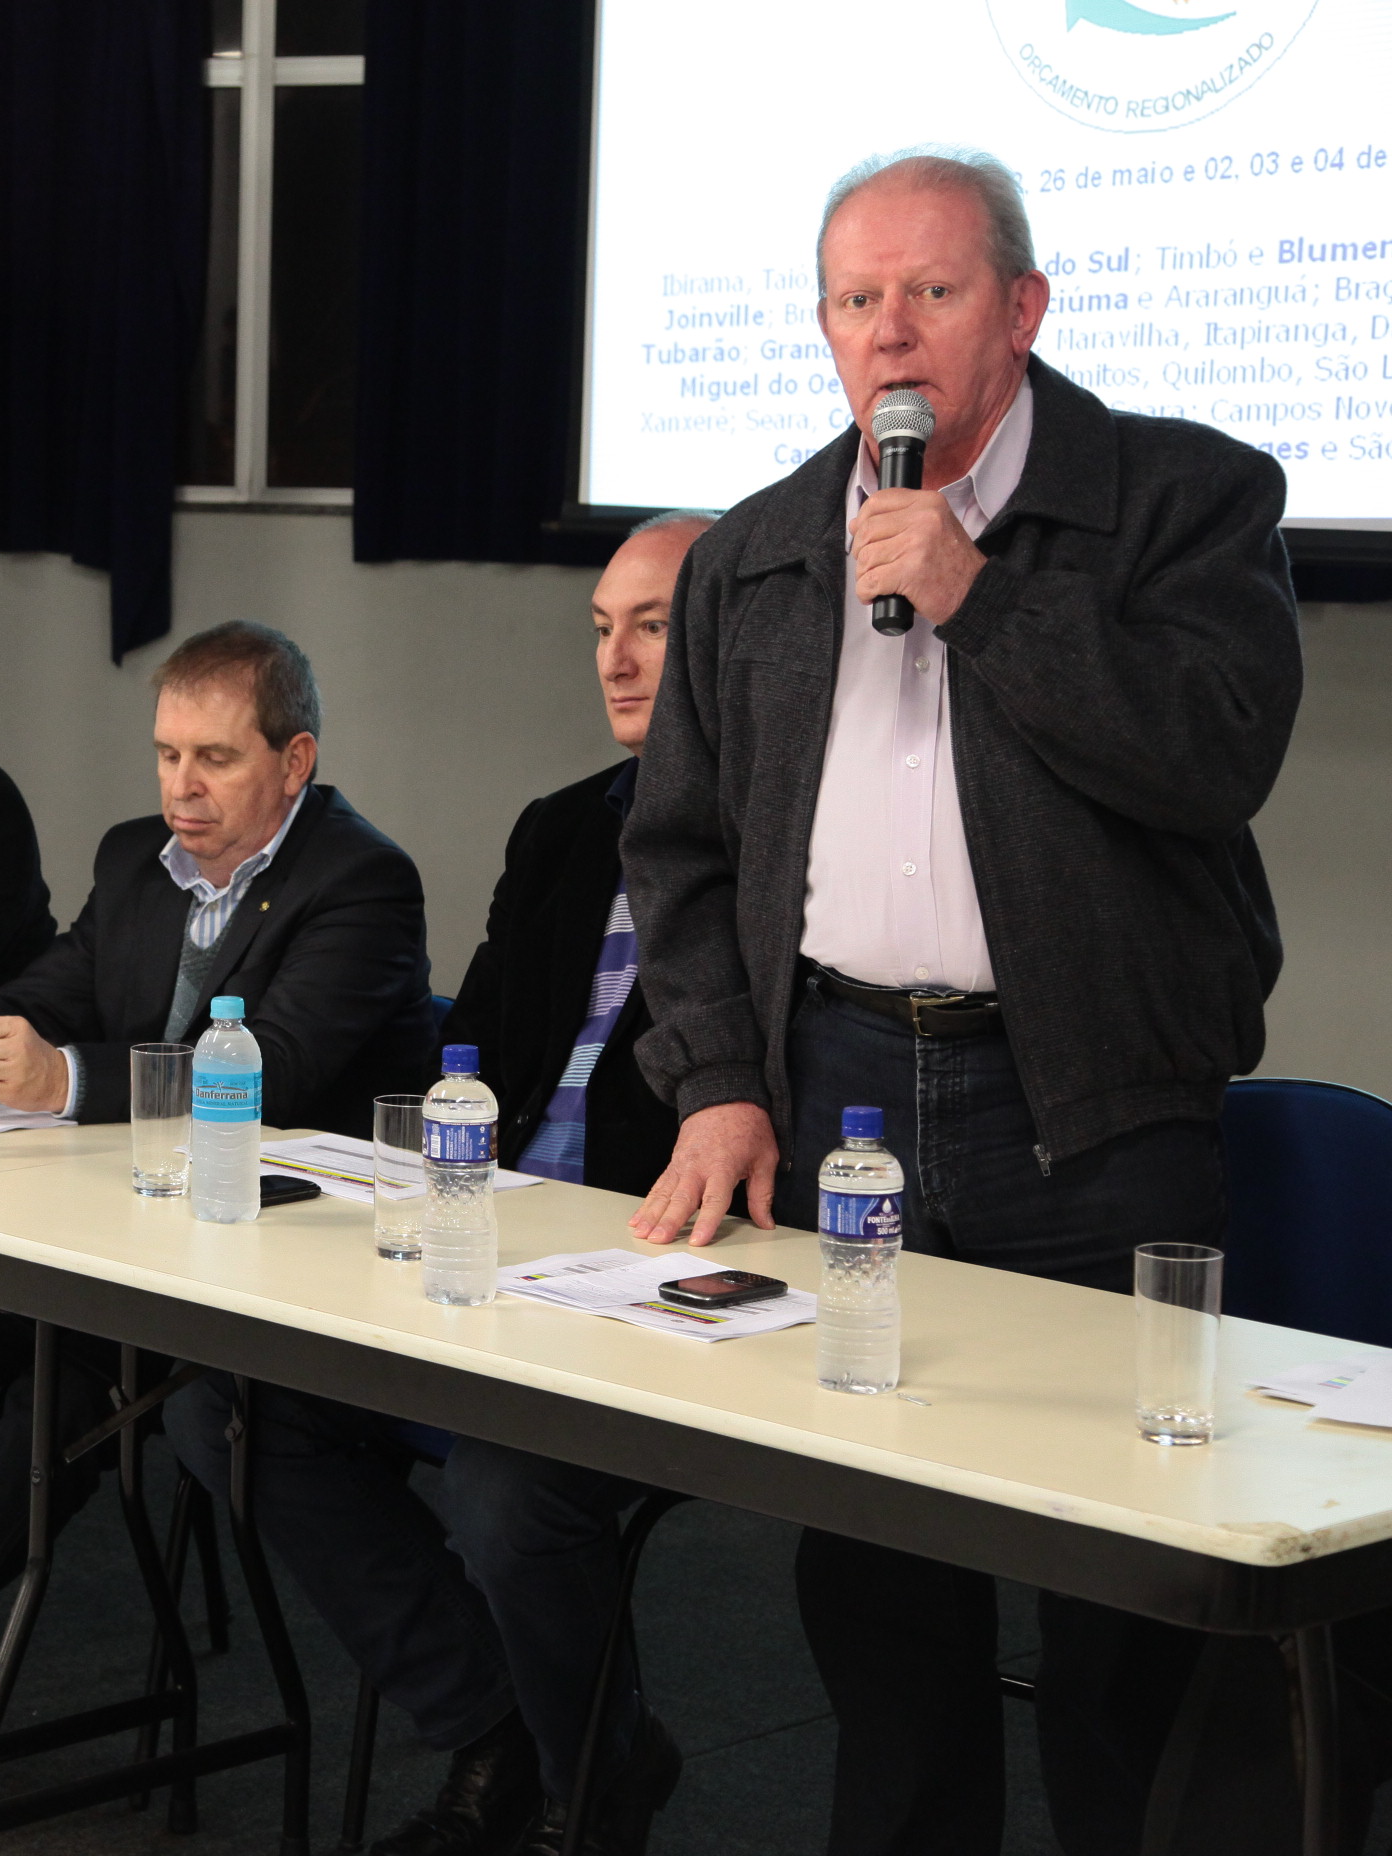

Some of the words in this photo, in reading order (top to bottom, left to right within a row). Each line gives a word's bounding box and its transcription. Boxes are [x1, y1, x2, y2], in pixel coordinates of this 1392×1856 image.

[1019, 43, 1119, 117] ORÇAMENTO
[1126, 31, 1275, 119] REGIONALIZADO
[1039, 168, 1066, 193] 26
[1075, 166, 1103, 190] de
[1112, 161, 1174, 187] maio
[1183, 165, 1196, 182] e
[1250, 151, 1280, 177] 03
[1291, 155, 1304, 174] e
[1314, 147, 1346, 172] 04
[1356, 144, 1388, 170] de
[1044, 251, 1076, 277] do
[1156, 238, 1238, 271] Timbó
[1248, 248, 1265, 267] e
[1138, 291, 1153, 310] e
[680, 373, 759, 402] Miguel
[768, 372, 798, 395] do
[1314, 353, 1369, 383] São
[1210, 398, 1324, 427] Campos
[1321, 440, 1338, 461] e
[195, 1087, 248, 1099] Danferrana
